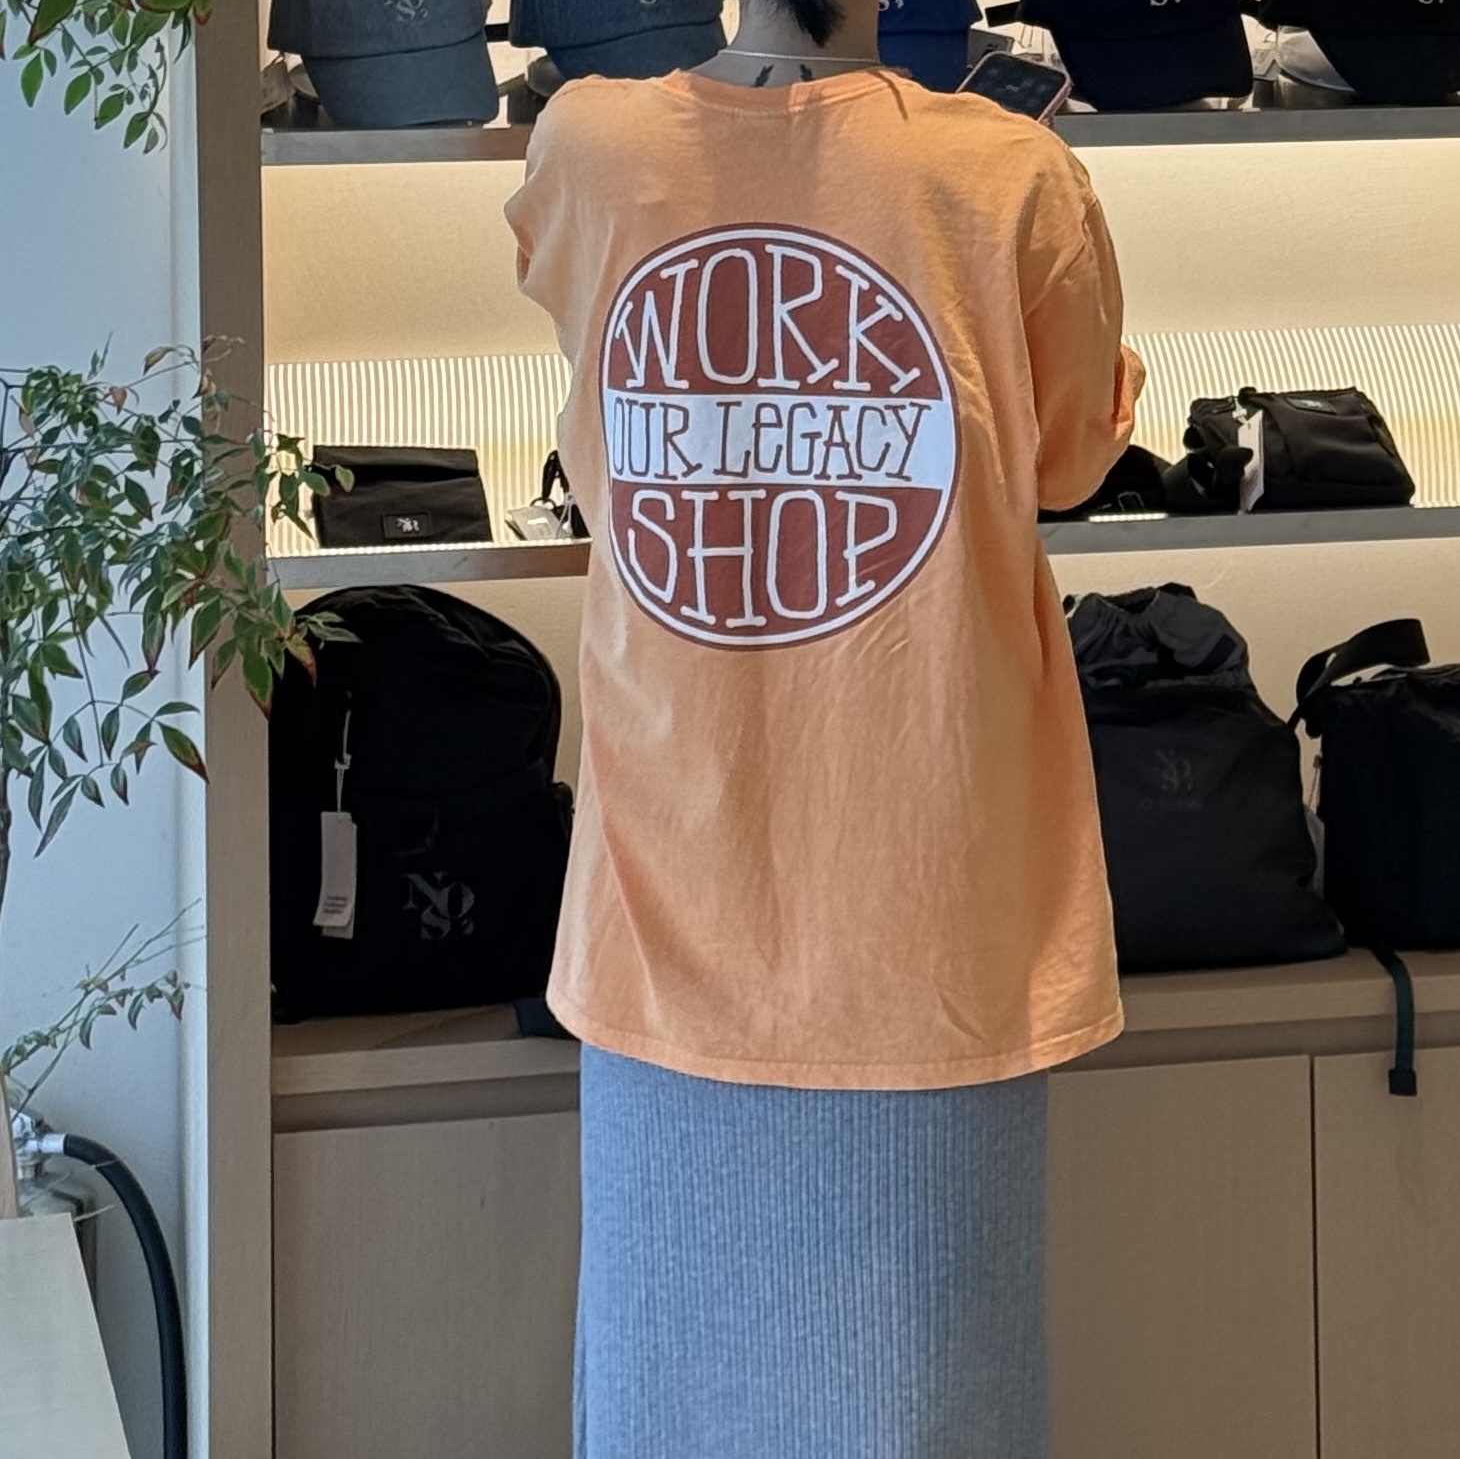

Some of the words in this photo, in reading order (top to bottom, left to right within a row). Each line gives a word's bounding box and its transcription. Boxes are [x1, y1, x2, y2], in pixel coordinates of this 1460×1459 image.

[615, 244, 920, 393] WORK
[613, 397, 702, 482] OUR
[627, 489, 898, 627] SHOP
